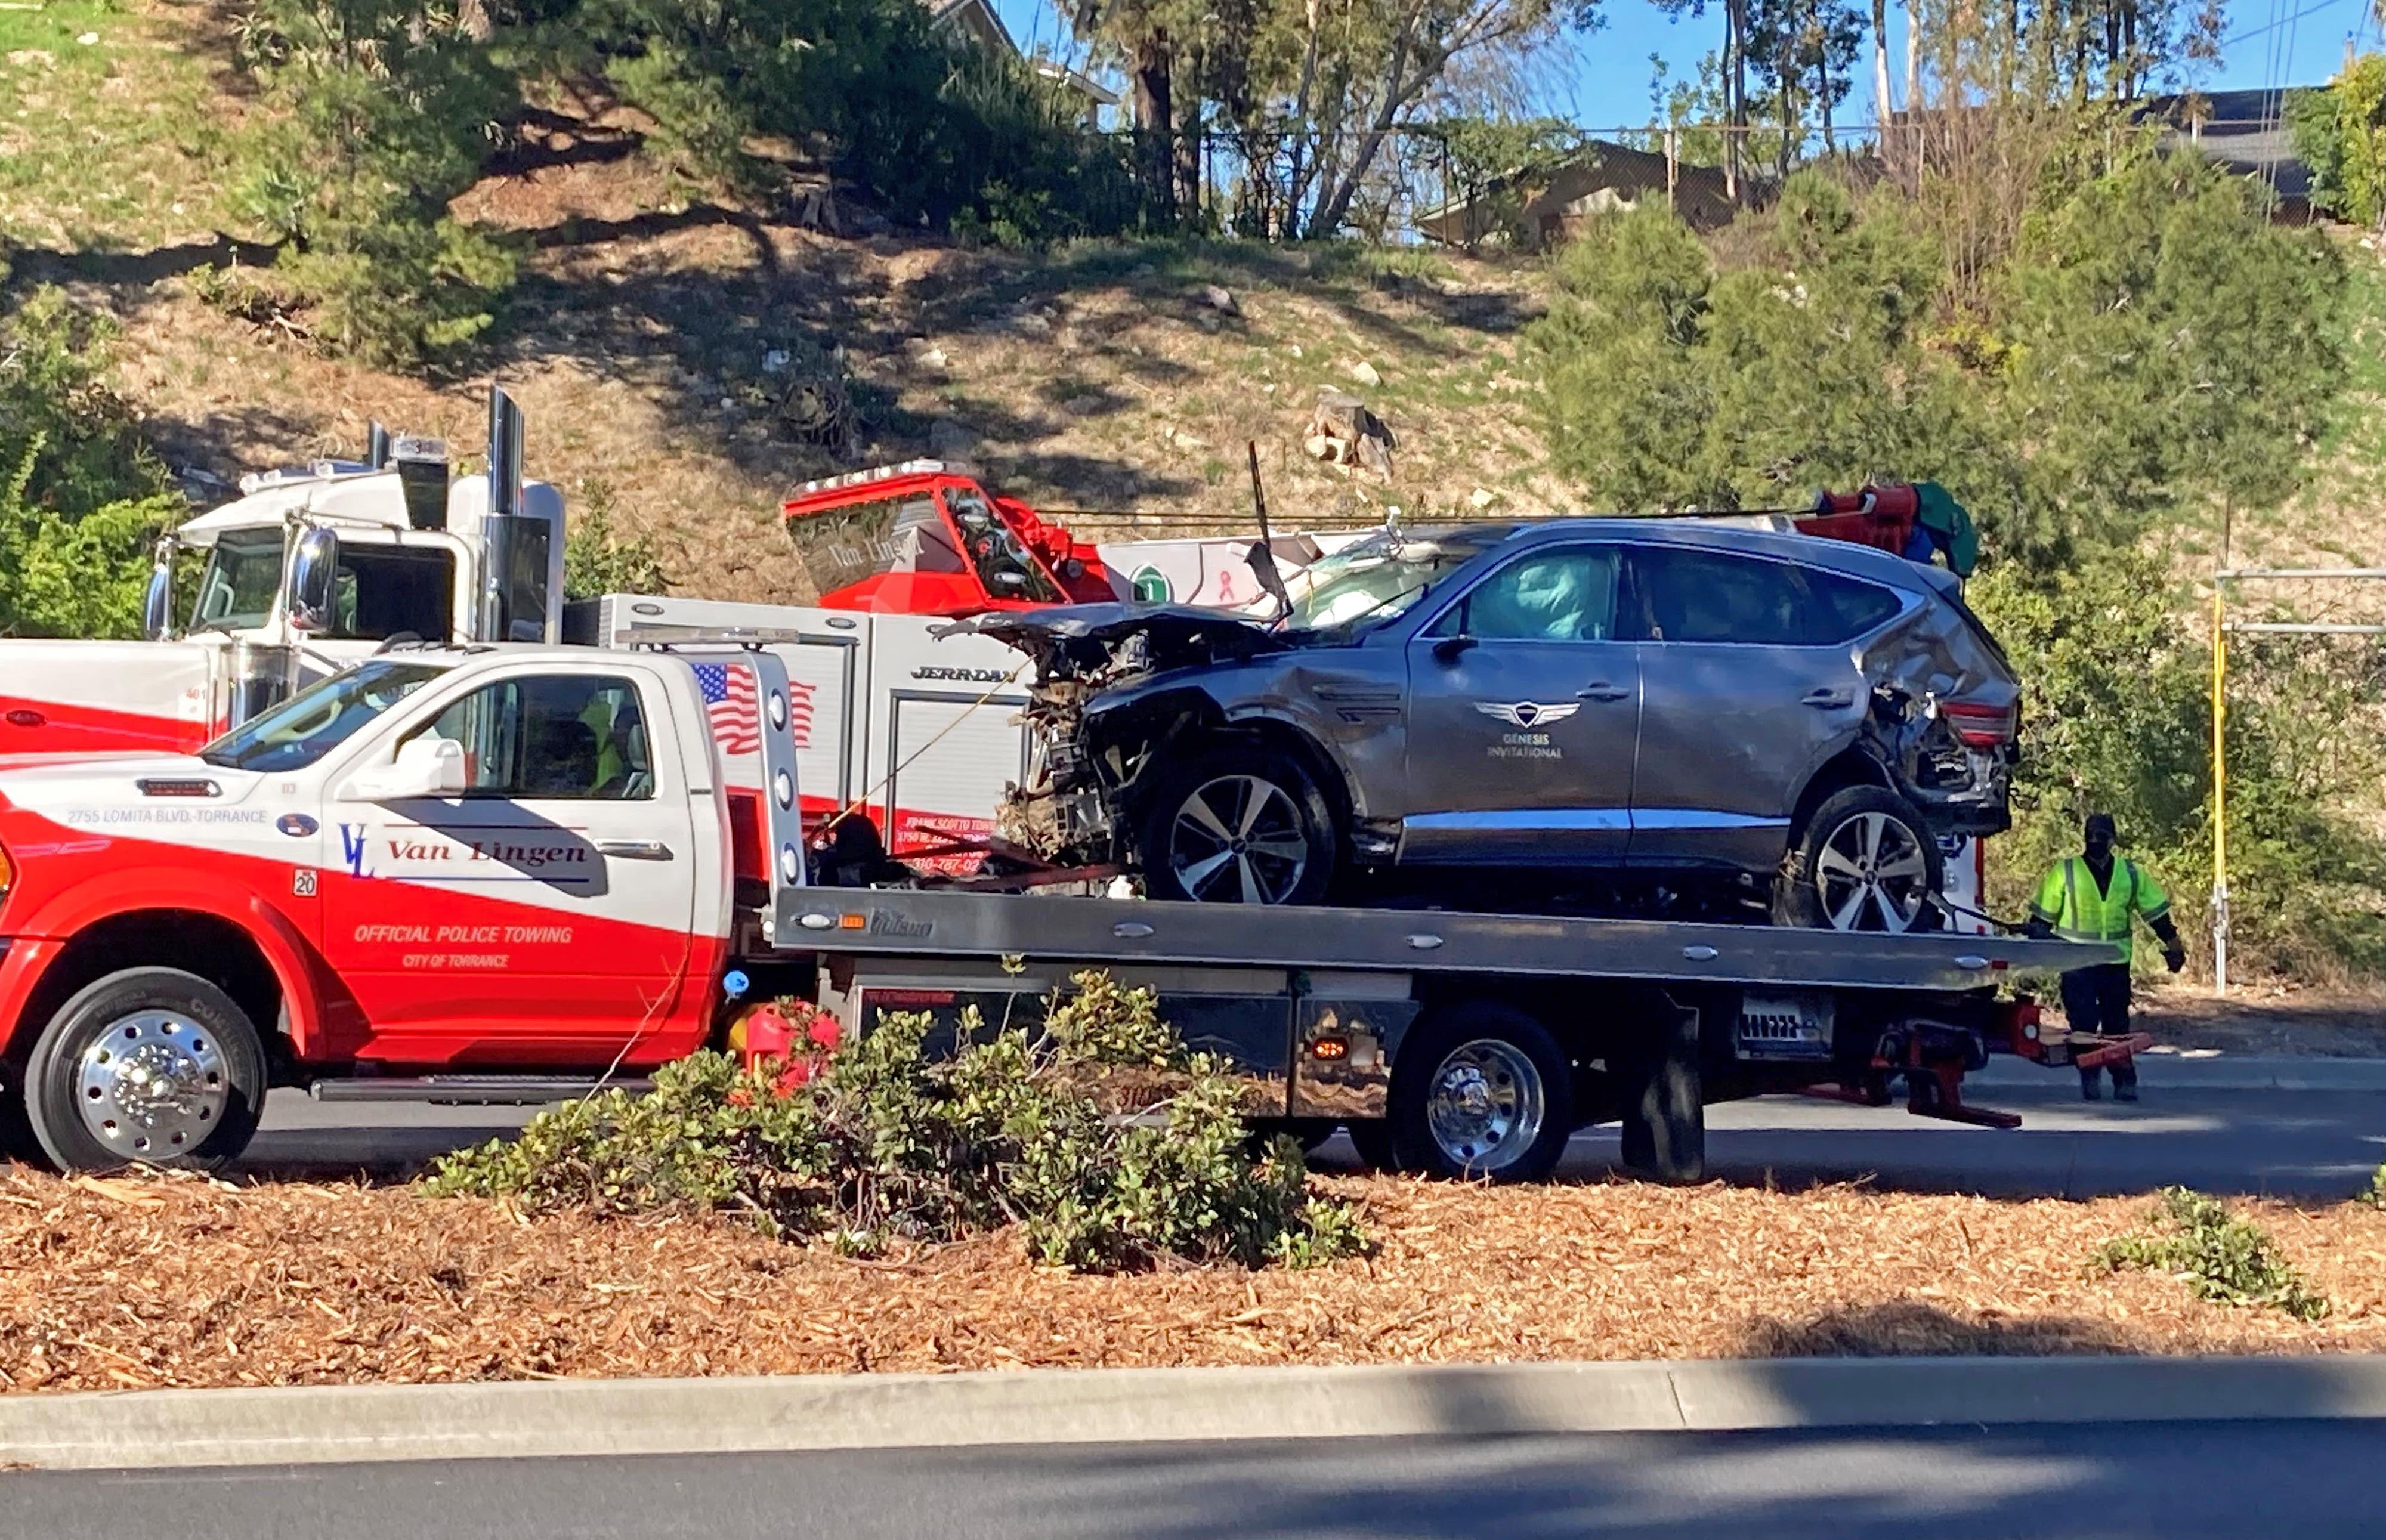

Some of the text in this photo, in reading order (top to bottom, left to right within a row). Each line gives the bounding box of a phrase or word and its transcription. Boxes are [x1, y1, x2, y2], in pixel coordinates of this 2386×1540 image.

[1503, 734, 1550, 745] GENESIS
[1487, 746, 1563, 759] INVITATIONAL
[67, 809, 100, 823] 2755
[103, 809, 152, 823] LOMITA
[388, 839, 588, 866] Van Lingen
[296, 876, 315, 893] 20
[354, 924, 573, 944] OFFICIAL POLICE TOWING
[402, 954, 510, 969] CITY OF TORRANCE
